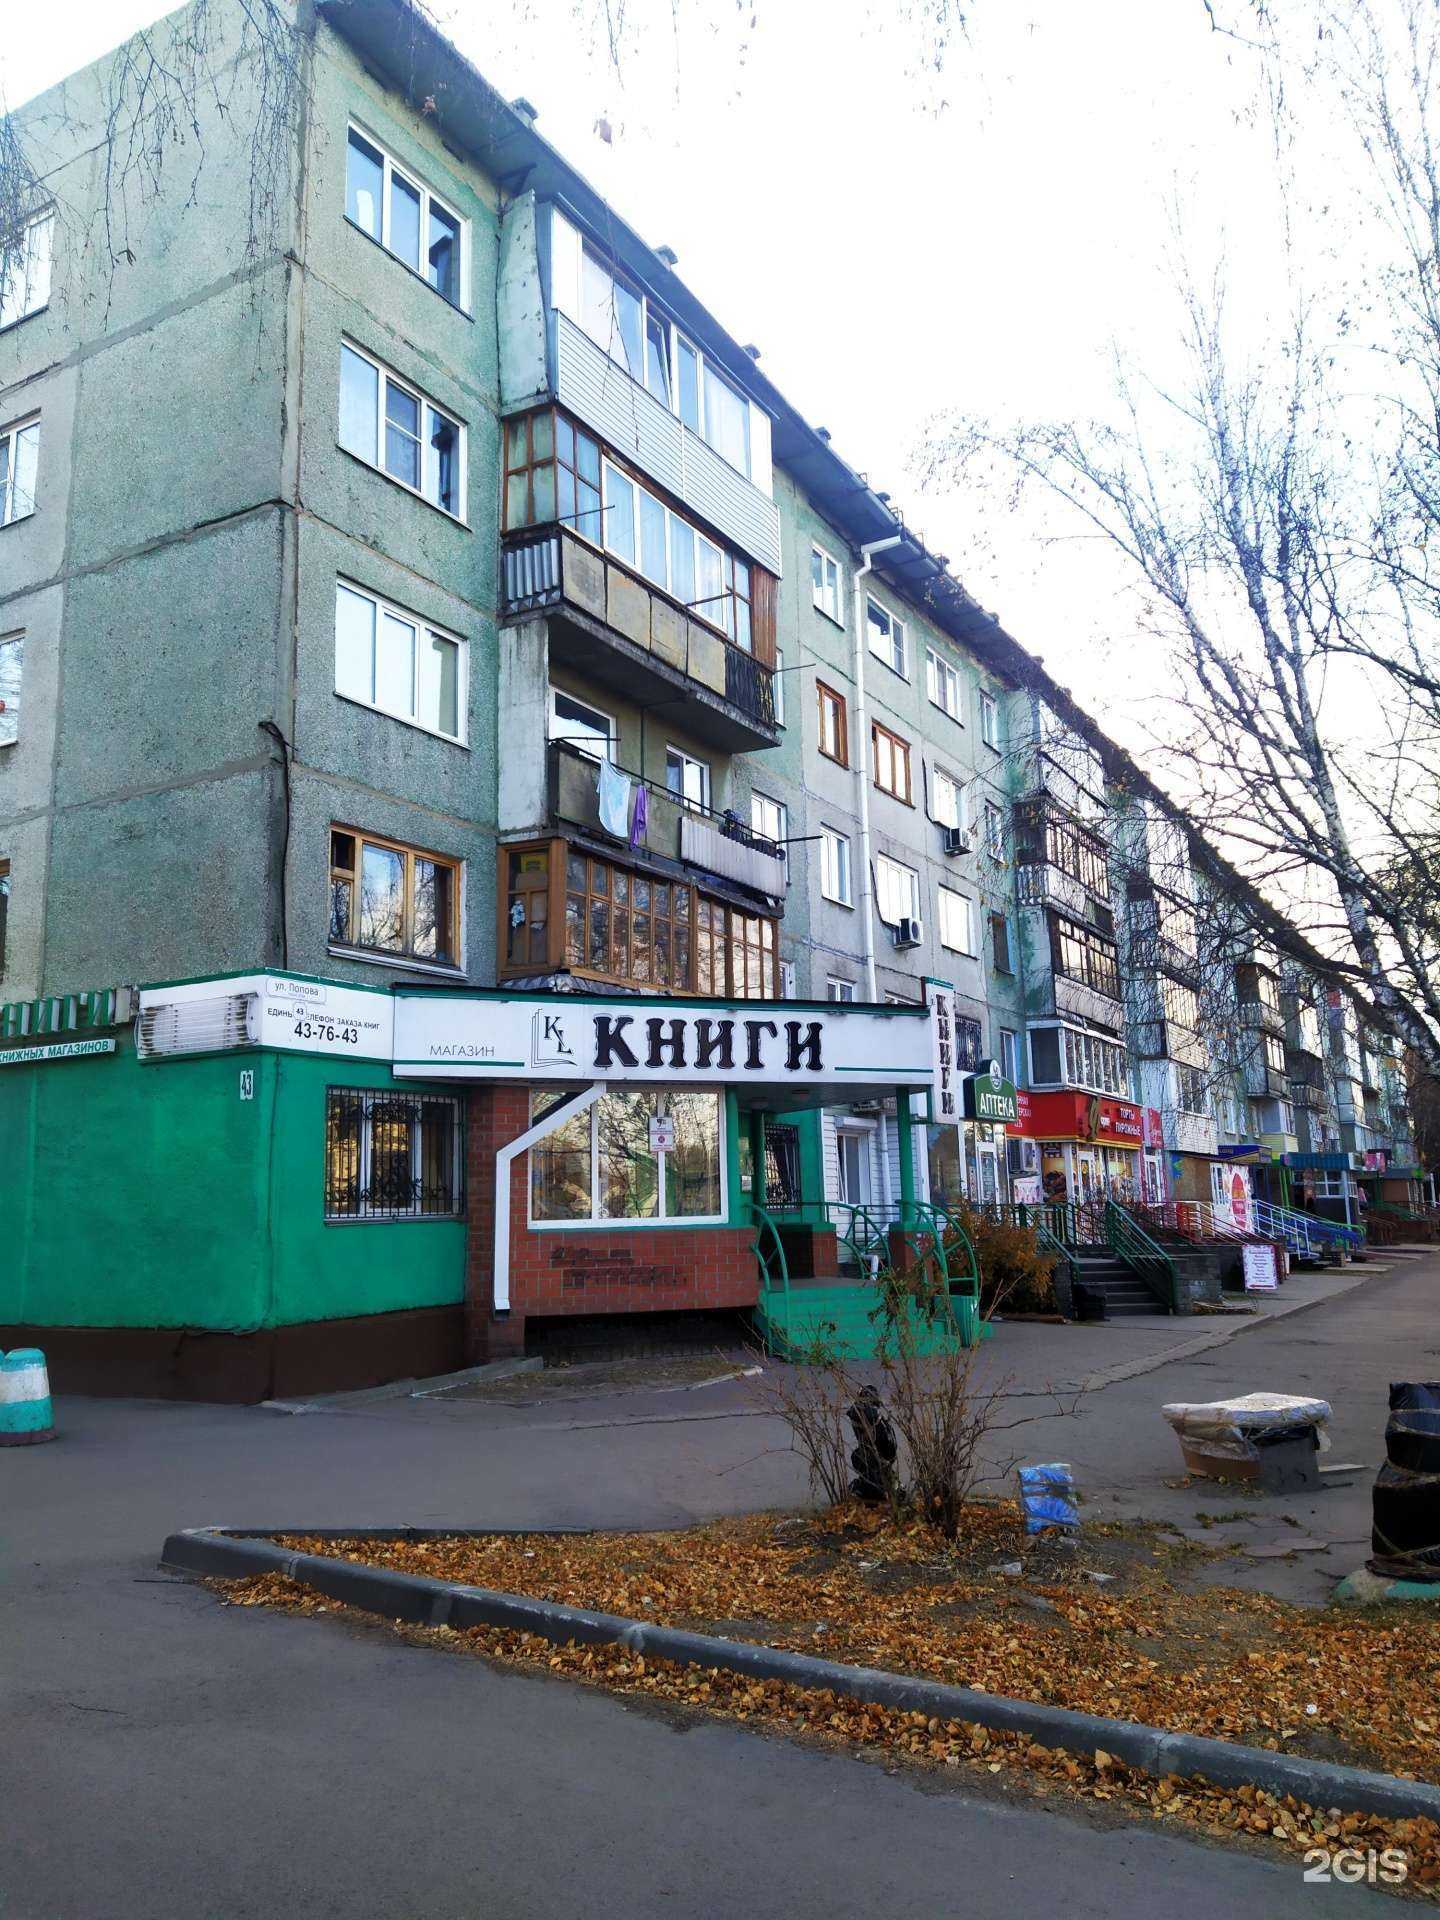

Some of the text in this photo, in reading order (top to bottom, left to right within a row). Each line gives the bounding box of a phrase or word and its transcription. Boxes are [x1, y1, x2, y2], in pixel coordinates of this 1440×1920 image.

[289, 983, 319, 996] Попова
[295, 1007, 304, 1015] 43
[294, 1022, 358, 1044] 43-76-43
[337, 1018, 362, 1028] ЗАКАЗА
[364, 1022, 380, 1031] КНИГ
[48, 1040, 109, 1057] МАГАЗИНОВ
[429, 1045, 495, 1057] МАГАЗИН
[592, 1014, 824, 1071] КНИГИ
[935, 994, 954, 1115] КНИГИ
[242, 1074, 252, 1096] 43
[980, 1093, 1015, 1118] АПТЕКА
